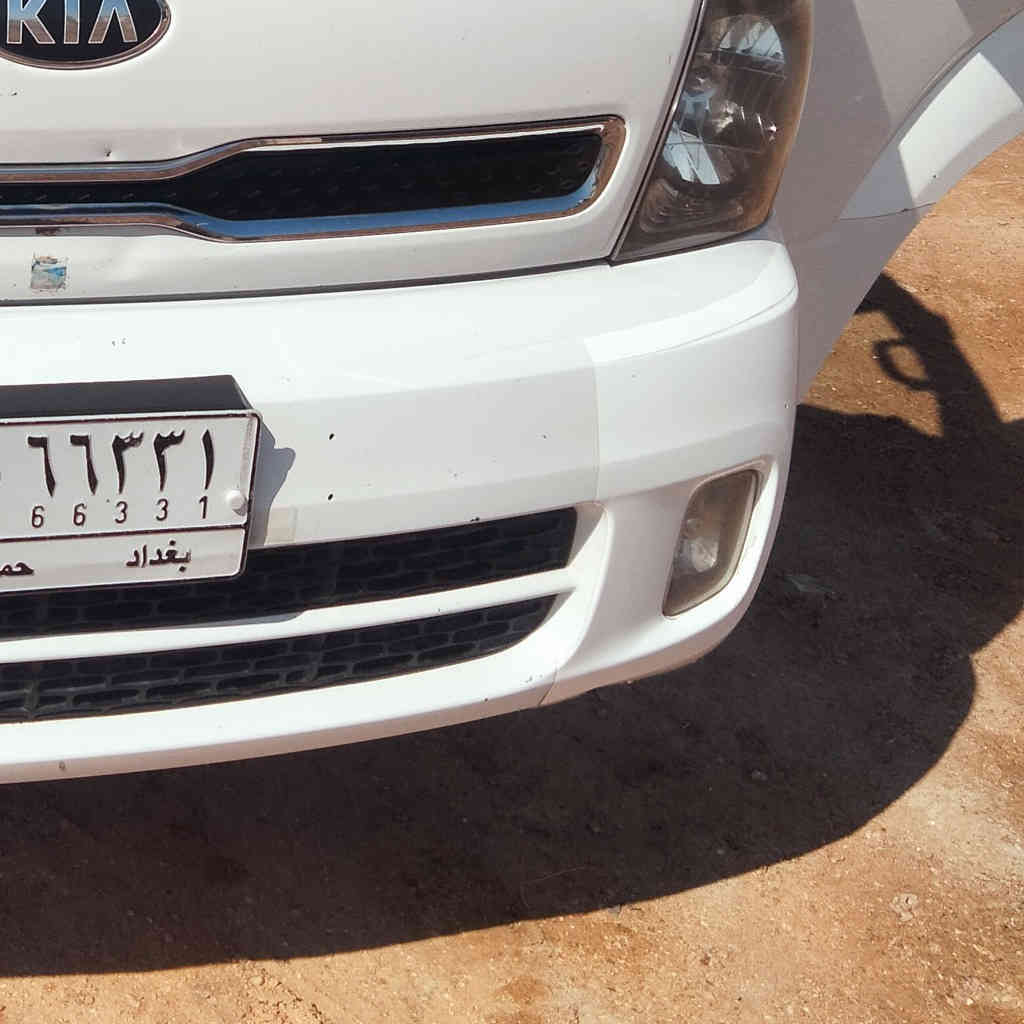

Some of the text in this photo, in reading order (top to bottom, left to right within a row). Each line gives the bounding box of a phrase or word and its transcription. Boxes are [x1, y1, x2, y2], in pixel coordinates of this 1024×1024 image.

[27, 429, 215, 497] ٦٦٣٣١
[31, 495, 209, 528] 66331
[125, 539, 192, 572] بغداد
